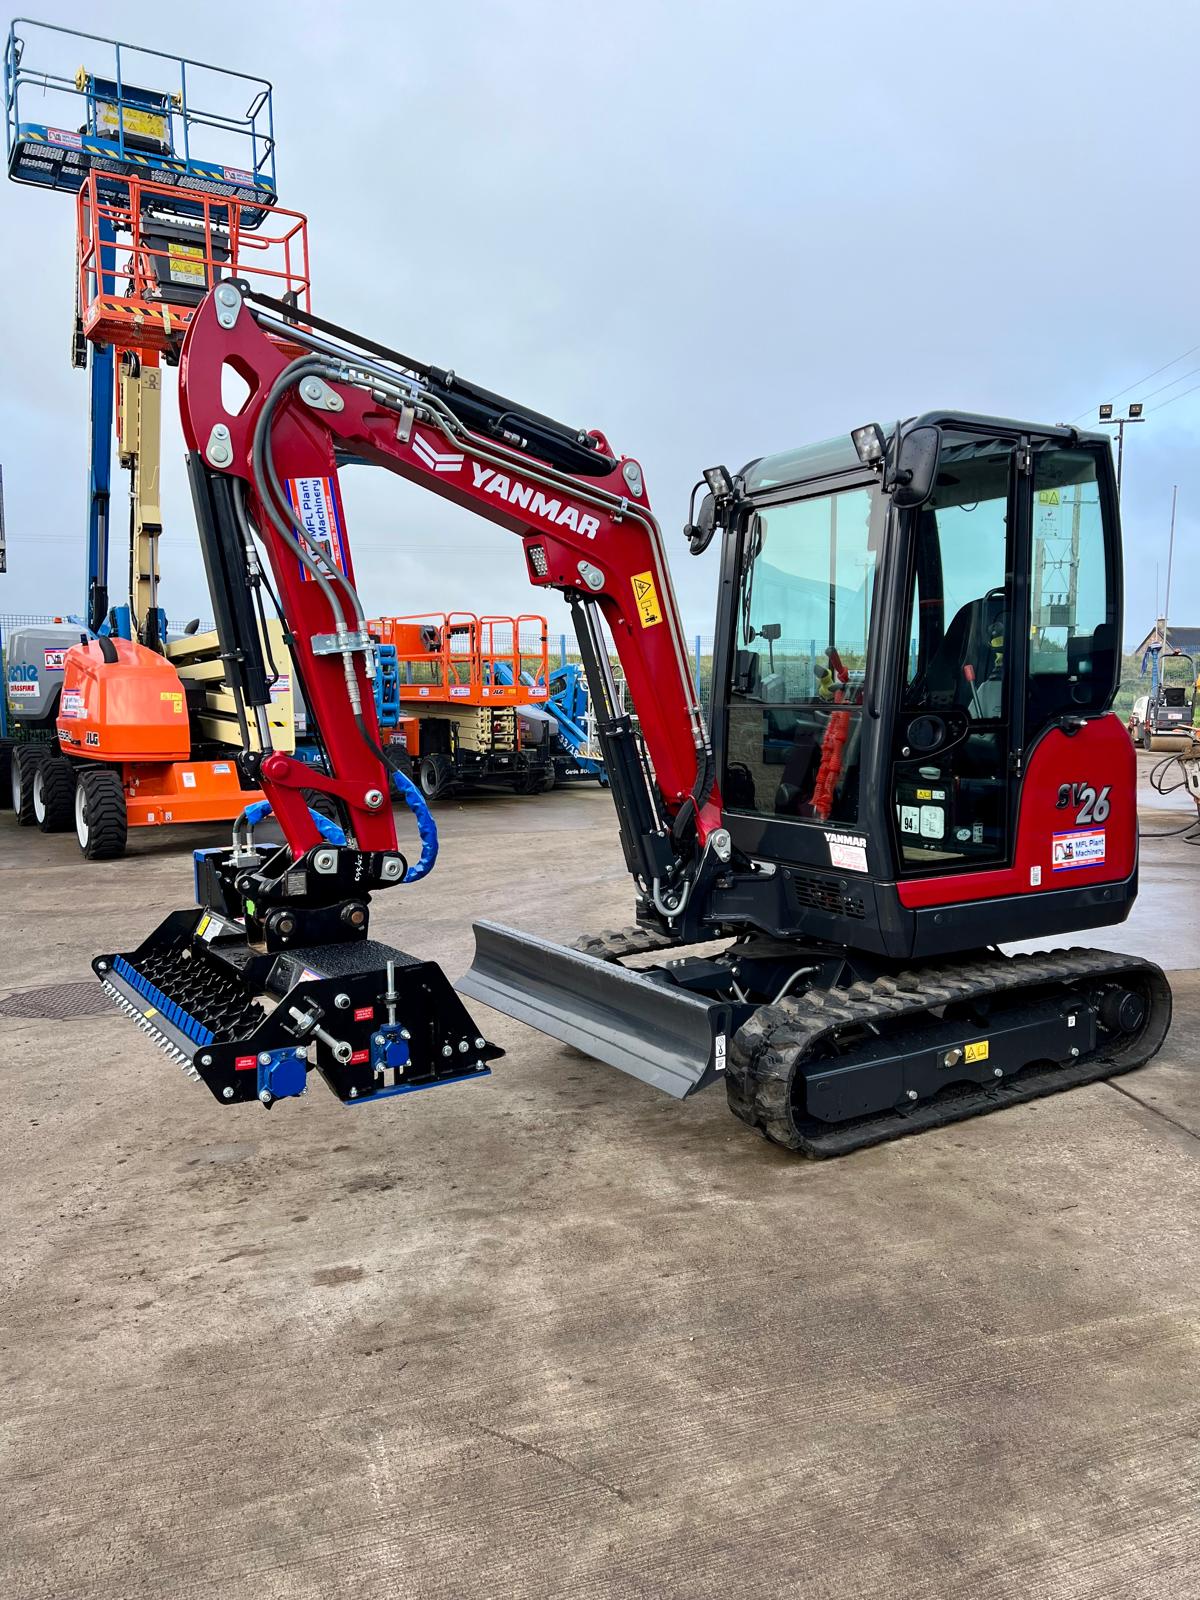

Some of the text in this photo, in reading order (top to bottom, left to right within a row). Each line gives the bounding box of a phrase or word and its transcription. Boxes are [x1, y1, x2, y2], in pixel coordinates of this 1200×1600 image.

[312, 480, 327, 536] Machinery
[472, 461, 600, 540] YANMAR
[300, 480, 317, 537] MFL Plant
[86, 732, 98, 745] JLG
[904, 817, 913, 831] 94
[823, 832, 867, 848] YANMAR
[1075, 840, 1088, 848] MFL
[1089, 837, 1104, 846] Plant
[1075, 848, 1104, 857] Machinery
